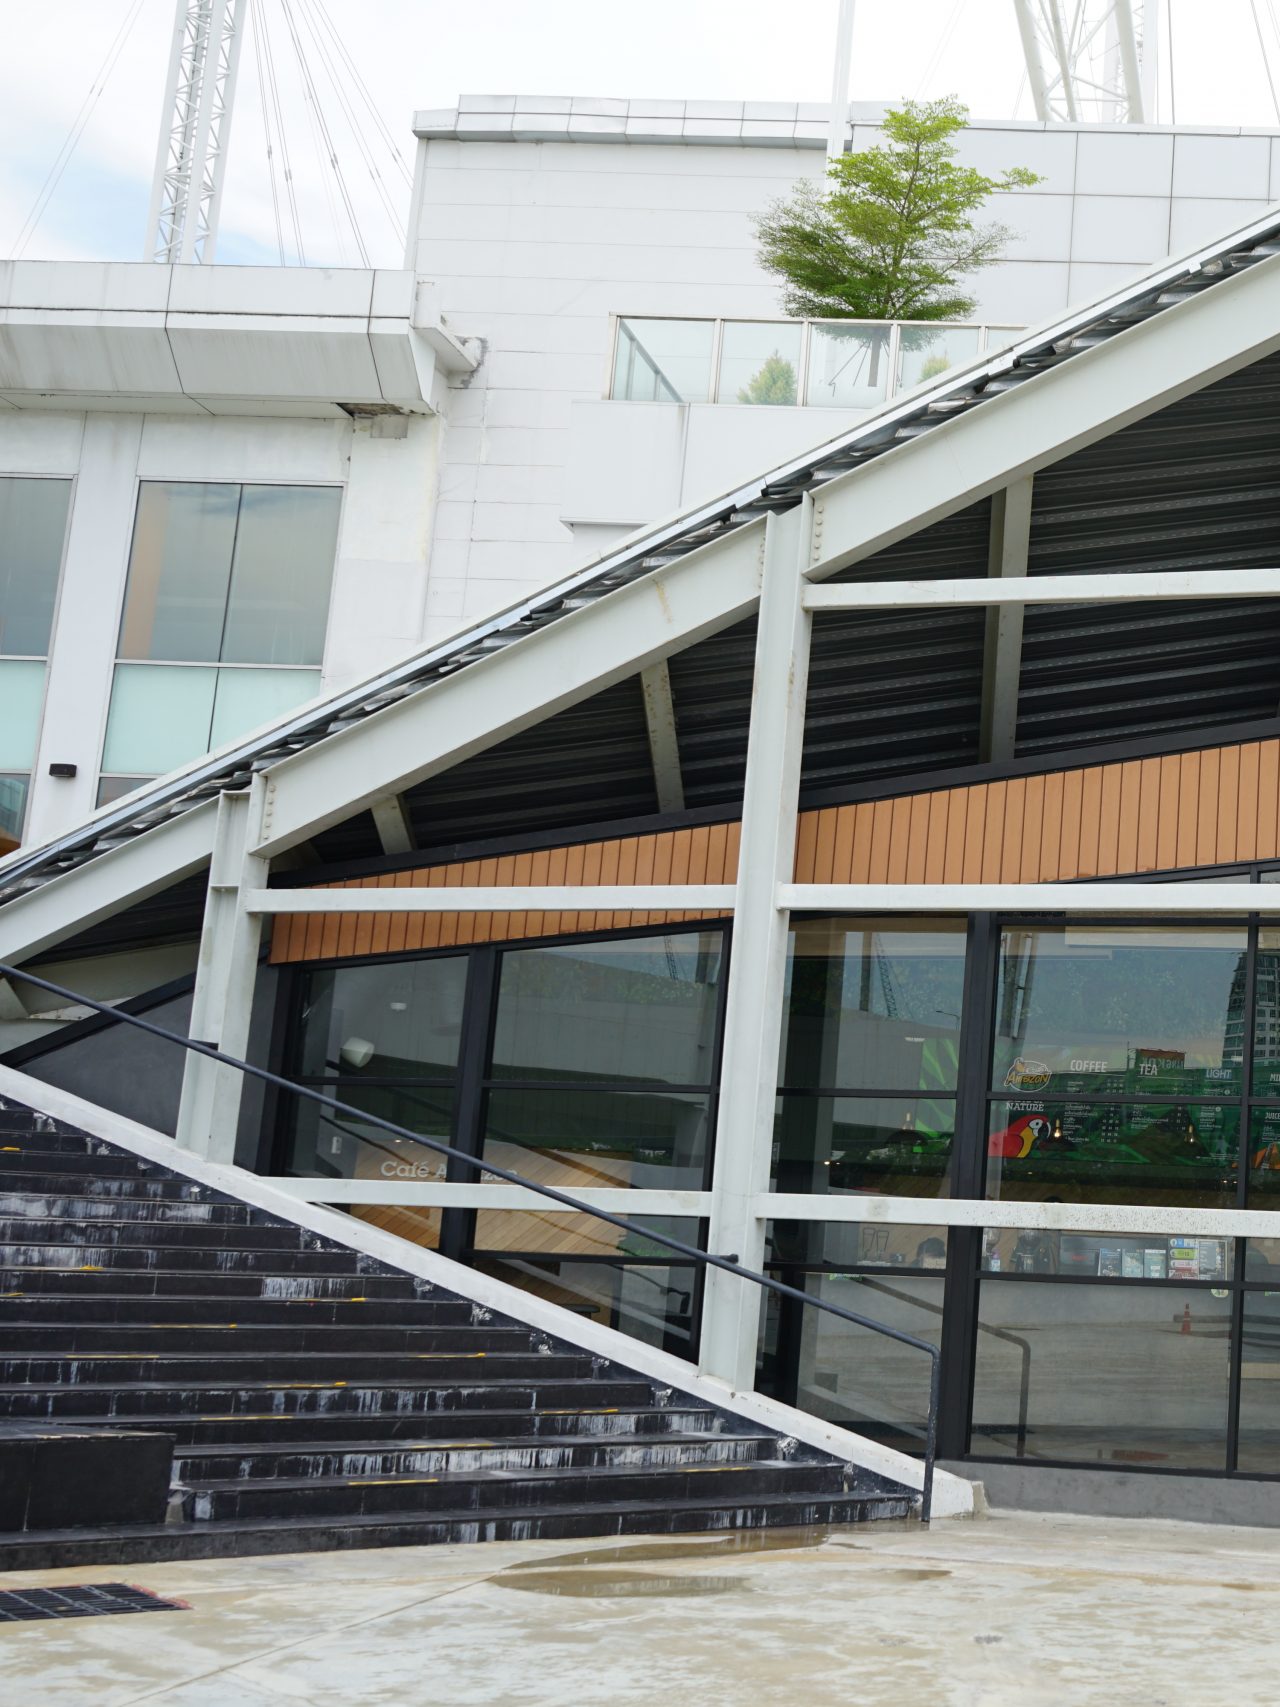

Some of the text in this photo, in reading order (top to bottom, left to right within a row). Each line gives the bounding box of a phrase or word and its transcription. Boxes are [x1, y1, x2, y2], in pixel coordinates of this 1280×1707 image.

[1070, 1060, 1108, 1072] COFFEE
[1139, 1064, 1158, 1075] TEA
[1206, 1069, 1232, 1079] LIGHT
[1005, 1102, 1045, 1112] NATURE
[1265, 1112, 1280, 1120] JUICE
[380, 1161, 429, 1178] Café
